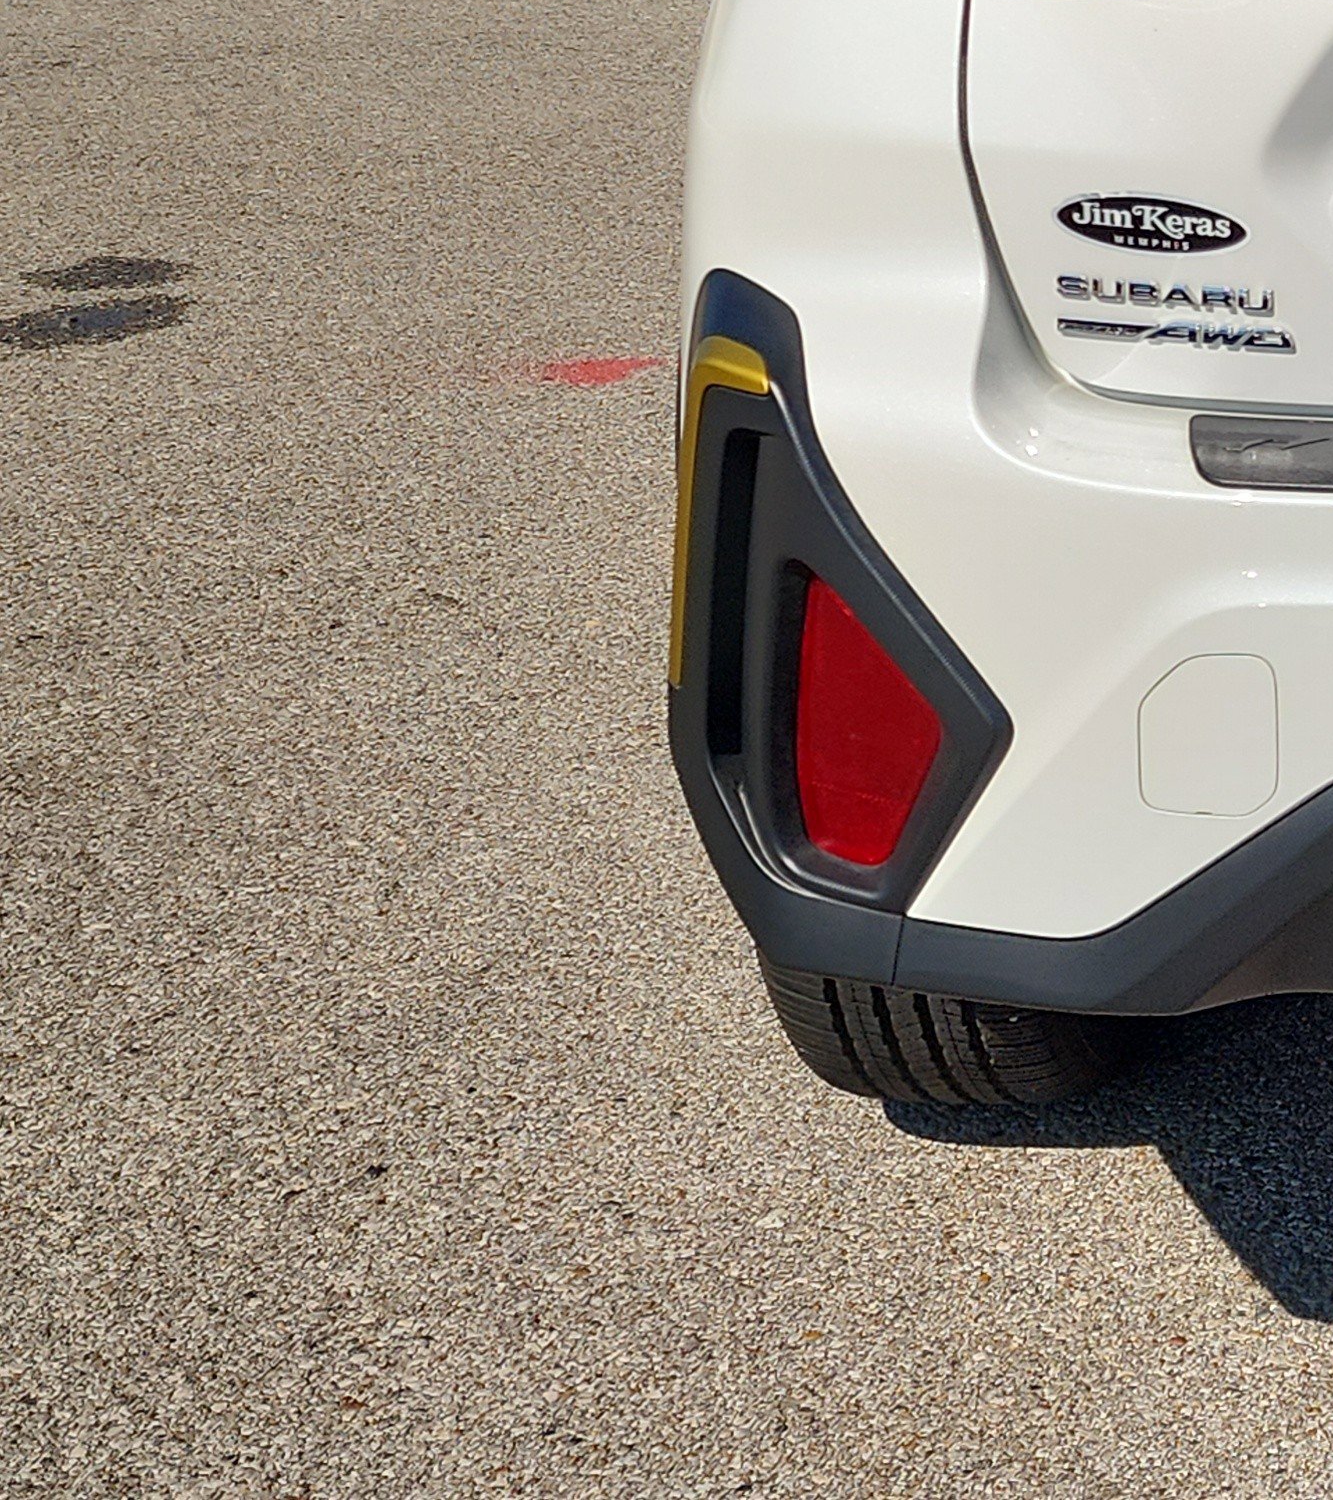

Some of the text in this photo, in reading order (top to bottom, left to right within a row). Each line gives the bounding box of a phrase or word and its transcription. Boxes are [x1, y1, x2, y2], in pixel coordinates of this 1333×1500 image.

[1071, 201, 1232, 240] Jim Keras
[1113, 234, 1191, 251] MEMPHIS
[1056, 274, 1275, 317] SUBARU
[1145, 320, 1297, 354] AWD
